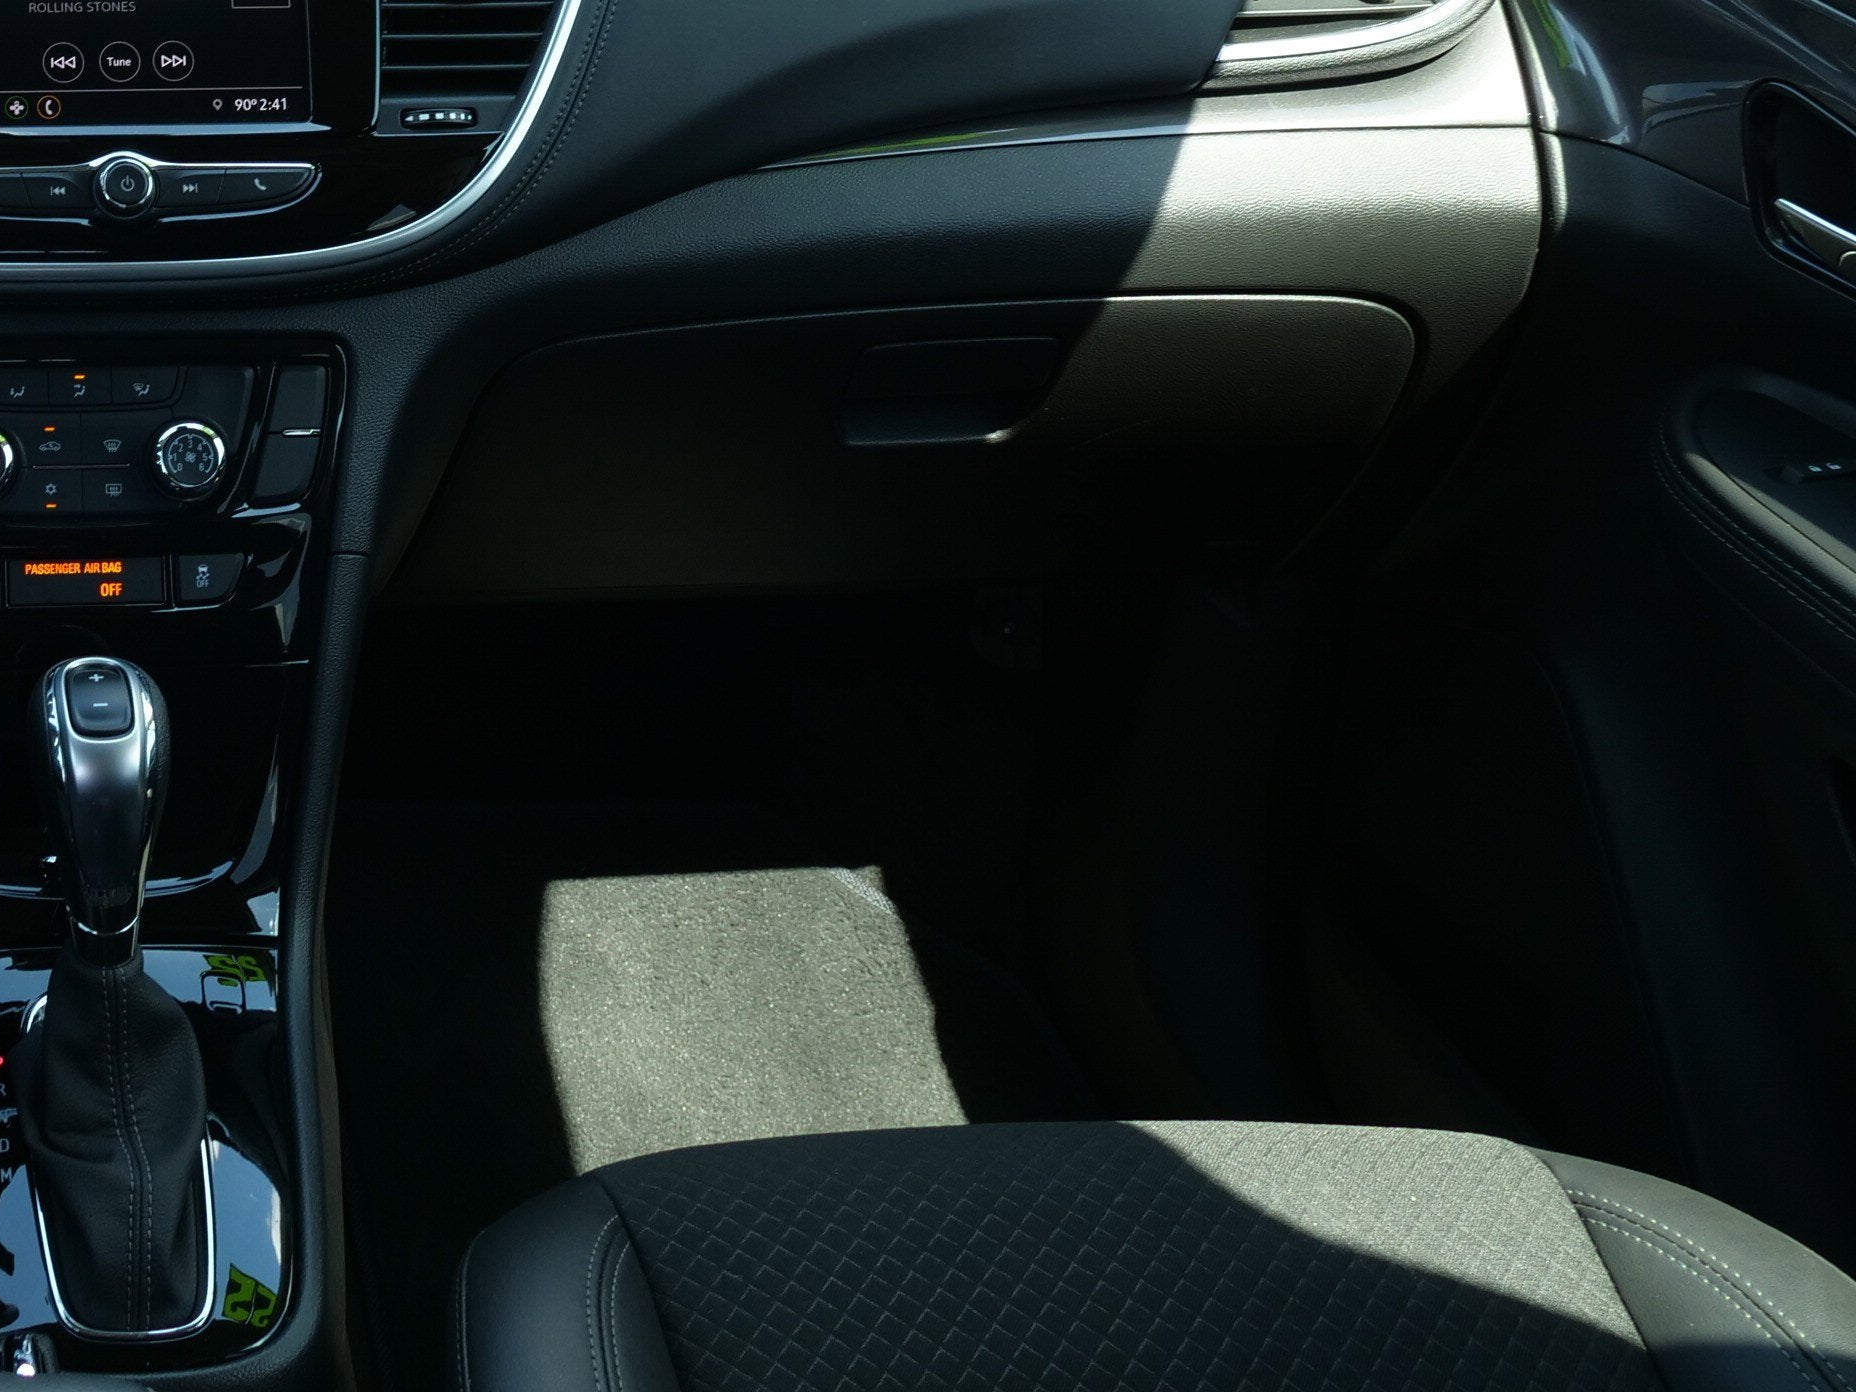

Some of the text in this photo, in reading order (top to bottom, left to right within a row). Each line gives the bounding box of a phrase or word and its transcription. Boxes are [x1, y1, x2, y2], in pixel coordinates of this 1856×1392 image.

[28, 1, 136, 14] ROLLING STONES
[106, 57, 132, 68] Tune
[259, 97, 288, 111] 2:41
[24, 561, 122, 575] PASSENGER AIR BAG
[100, 582, 123, 597] OFF
[0, 1167, 13, 1183] M
